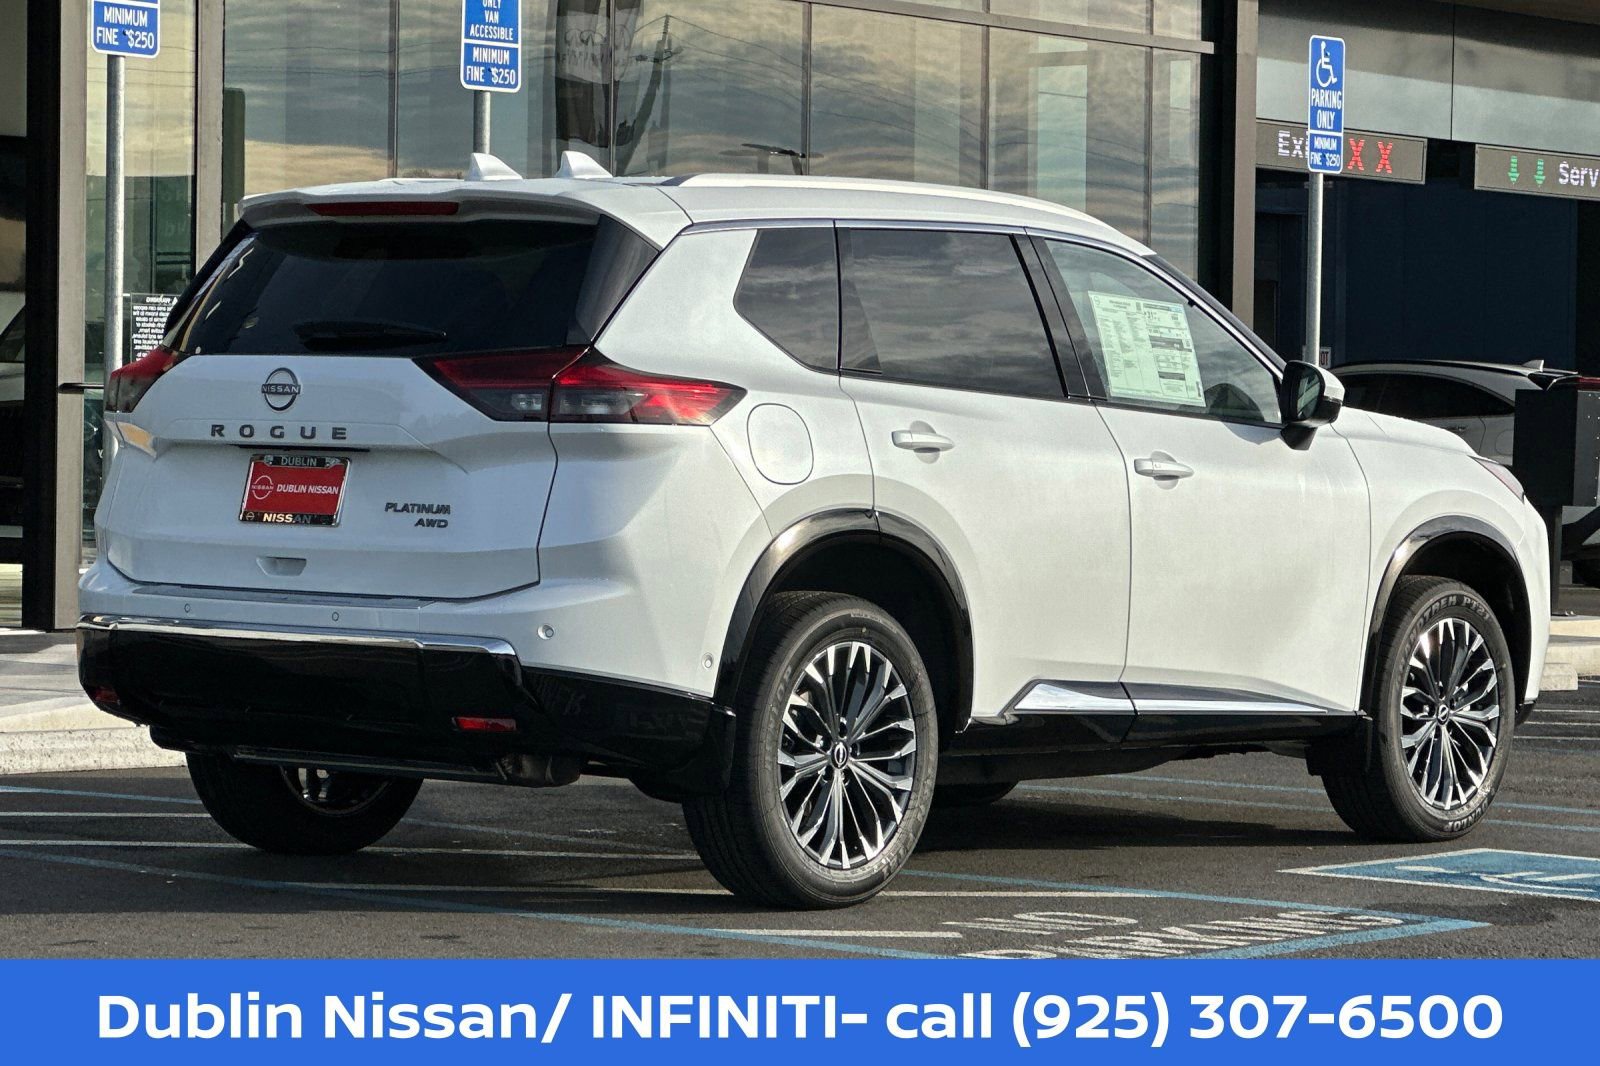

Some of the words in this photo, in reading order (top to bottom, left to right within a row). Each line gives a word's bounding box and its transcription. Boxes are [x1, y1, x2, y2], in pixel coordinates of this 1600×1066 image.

[103, 5, 148, 28] MINIMUM
[484, 10, 499, 24] VAN
[96, 26, 119, 46] FINE
[127, 28, 155, 50] $250
[469, 24, 514, 41] ACCESSIBLE
[472, 46, 510, 65] MINIMUM
[466, 66, 485, 82] FINE
[491, 67, 516, 85] $250
[1311, 88, 1342, 110] PARKING
[1316, 109, 1336, 130] ONLY
[1313, 137, 1337, 151] MINIMUM
[1310, 151, 1323, 166] FINE
[1325, 152, 1341, 167] $250
[261, 384, 300, 394] NISSAN
[210, 424, 347, 441] ROGUE
[281, 456, 317, 467] DUBLIN
[276, 484, 307, 494] DUBLIN
[307, 485, 340, 495] NISSAN
[384, 502, 451, 515] PLATINUM
[263, 512, 312, 525] NISSAN
[414, 517, 449, 529] AWD
[1443, 796, 1489, 831] DUNLOP
